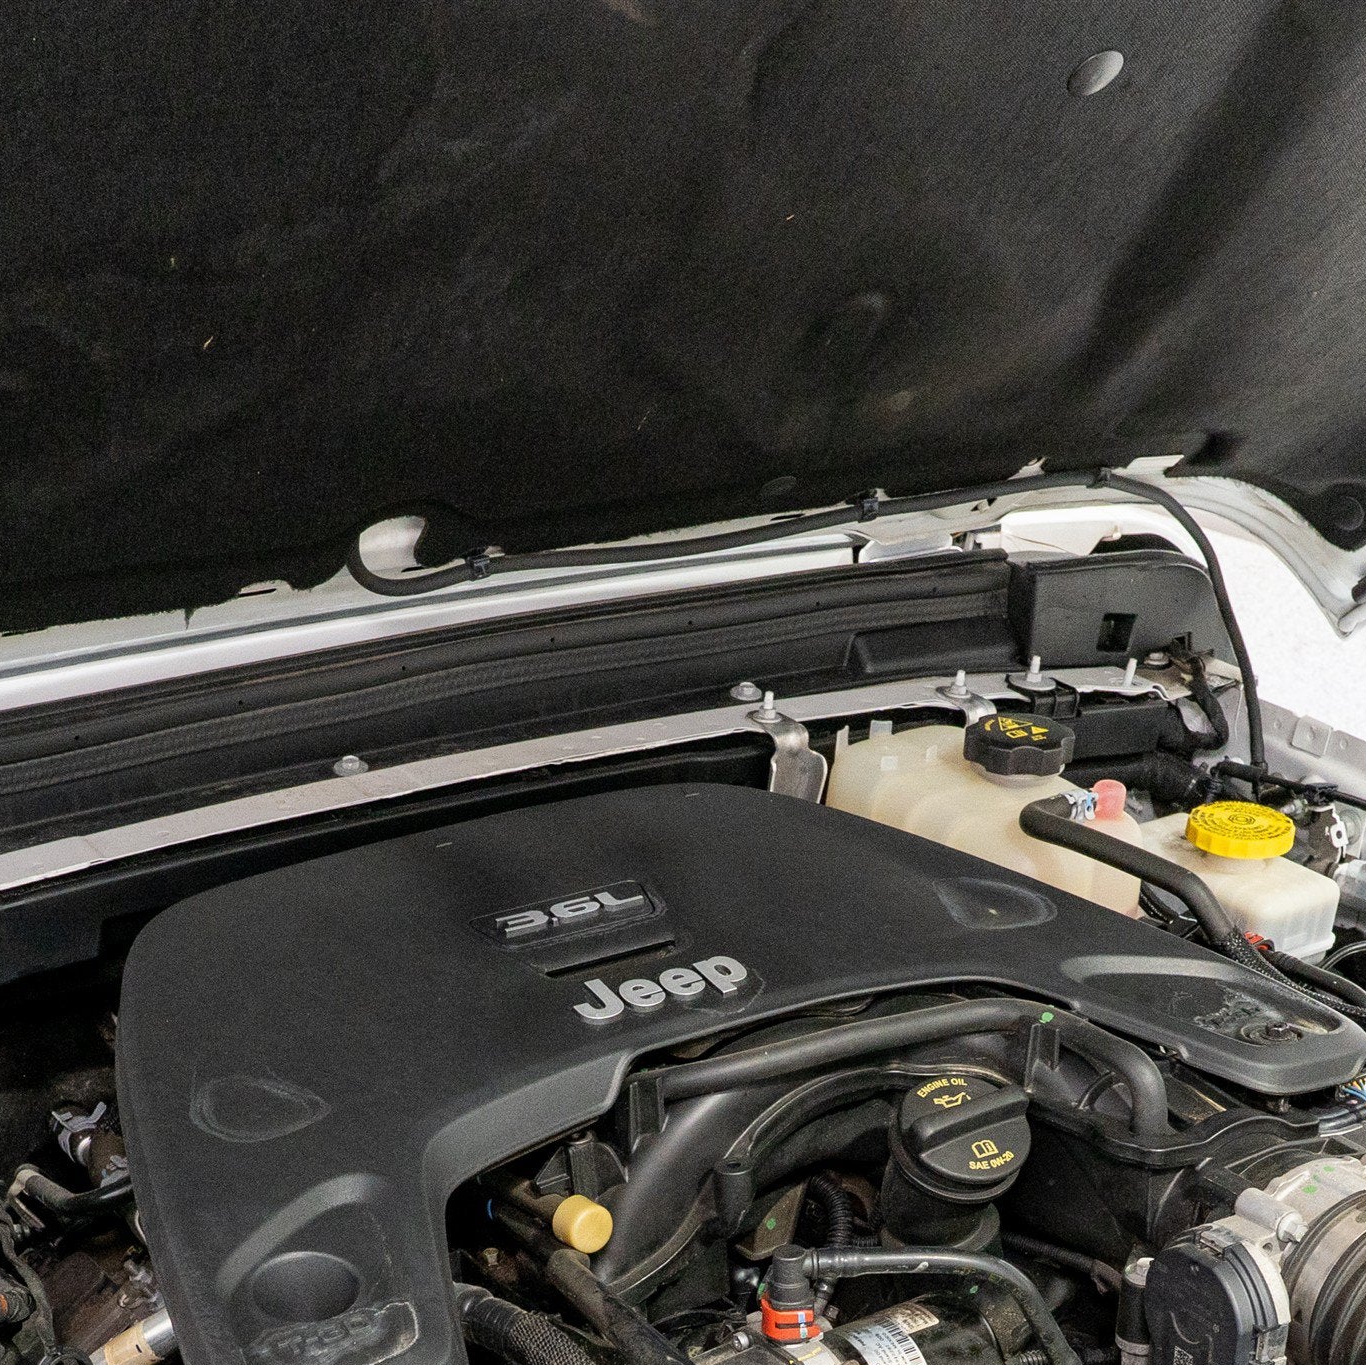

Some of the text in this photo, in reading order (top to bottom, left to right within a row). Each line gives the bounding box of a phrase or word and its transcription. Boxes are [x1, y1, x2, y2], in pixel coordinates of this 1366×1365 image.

[495, 891, 643, 939] 3.6L
[573, 955, 749, 1025] Jeep
[917, 1077, 968, 1098] ENGINE OIL
[969, 1150, 1015, 1171] SAE 0W-20
